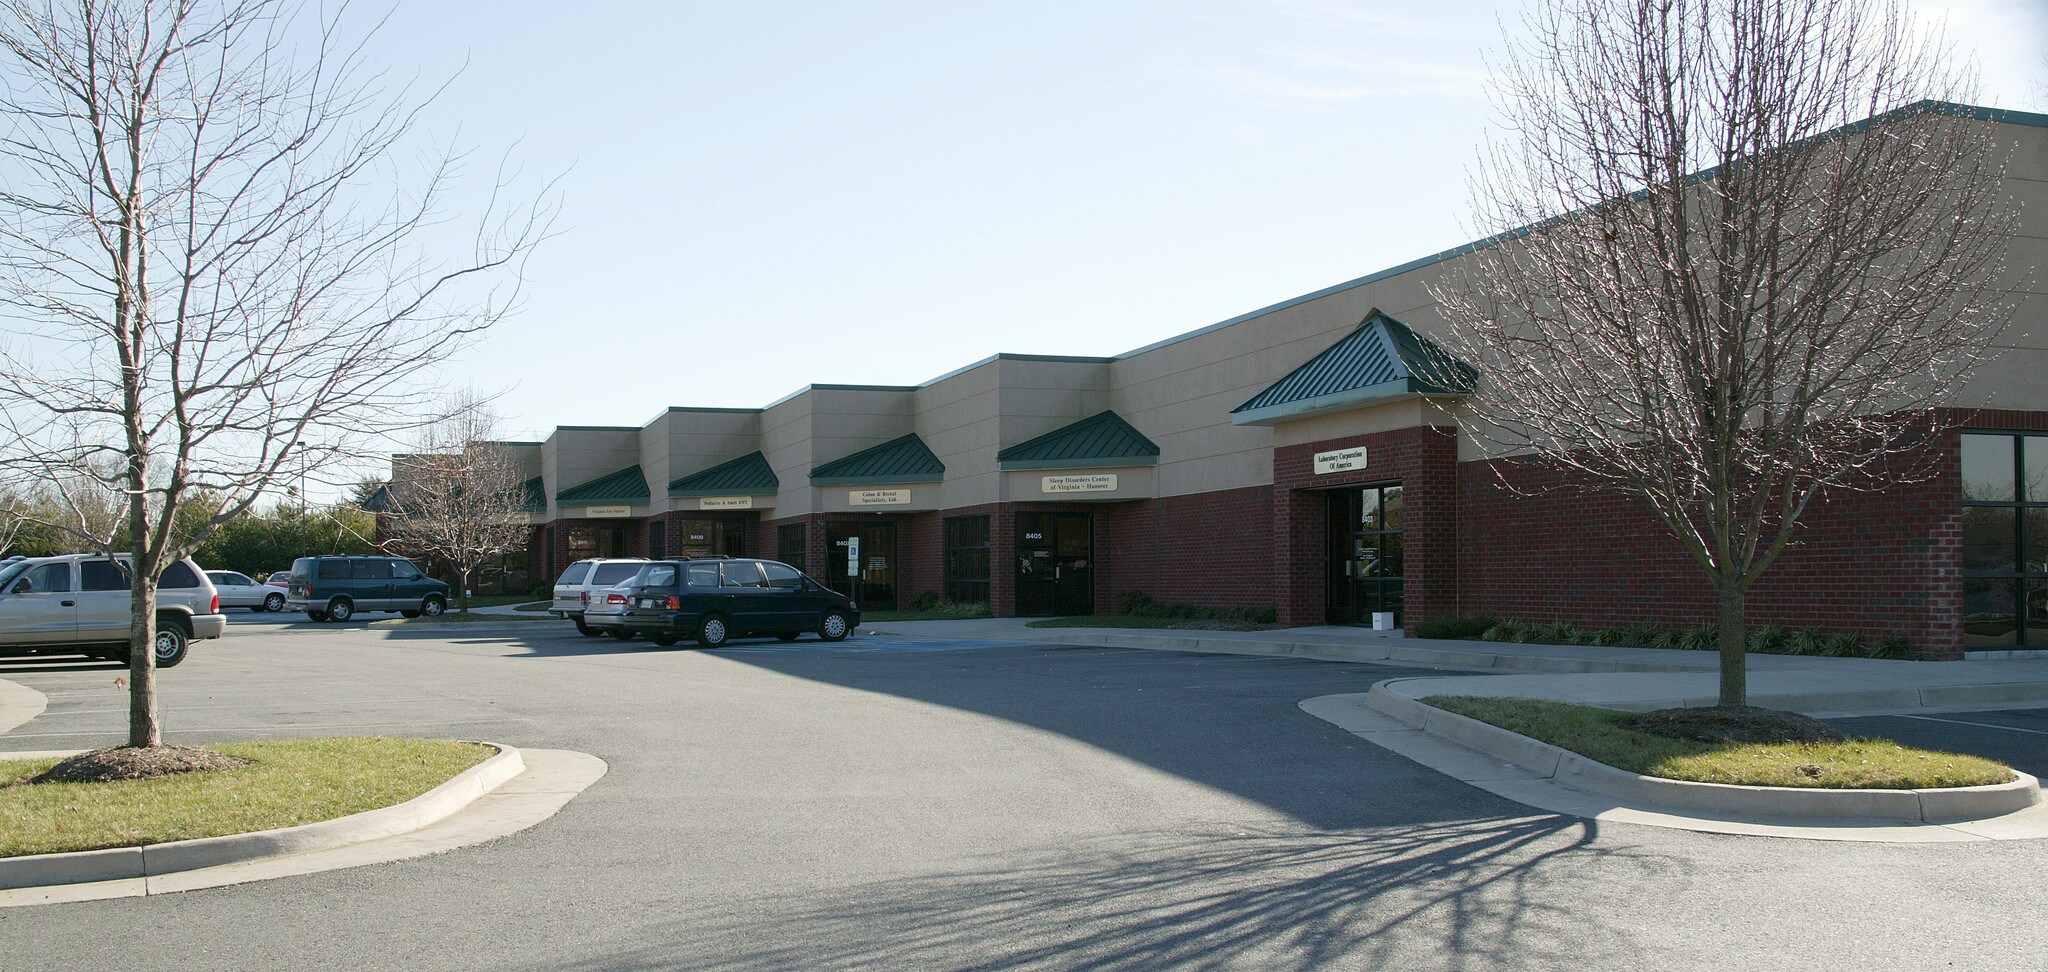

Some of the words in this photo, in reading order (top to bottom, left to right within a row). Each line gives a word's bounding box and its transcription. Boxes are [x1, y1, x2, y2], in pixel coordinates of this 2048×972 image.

[1318, 454, 1338, 463] Laboratory
[1339, 451, 1362, 460] Corporation
[1336, 461, 1352, 469] America
